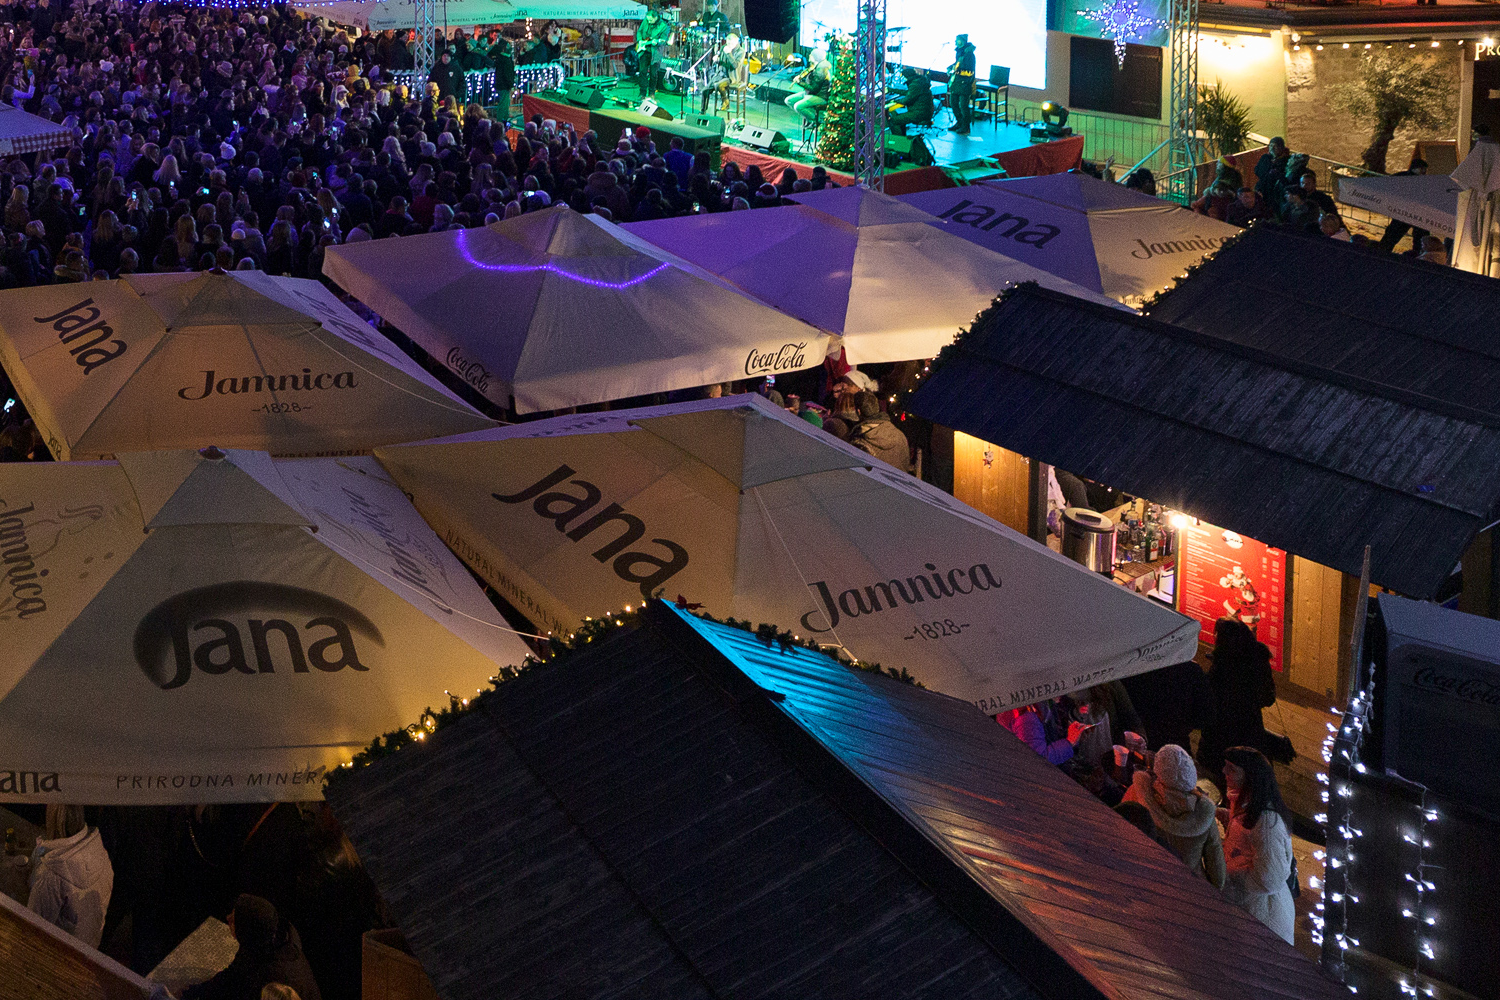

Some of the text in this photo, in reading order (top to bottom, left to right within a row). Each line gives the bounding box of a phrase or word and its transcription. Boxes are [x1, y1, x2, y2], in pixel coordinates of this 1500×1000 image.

[623, 8, 639, 17] Jana
[33, 297, 128, 376] Jana
[744, 341, 808, 376] Coca-Cola
[178, 367, 359, 401] Jamnica
[446, 346, 492, 394] Coca-Cola
[490, 463, 690, 600] Jana
[444, 529, 495, 579] NATURAL
[497, 571, 550, 625] MINERAL
[800, 562, 1003, 633] Jamnica
[158, 610, 370, 690] Jana
[1010, 680, 1068, 705] MINERAL
[1073, 666, 1115, 687] WATER
[116, 773, 235, 790] PRIRODNA
